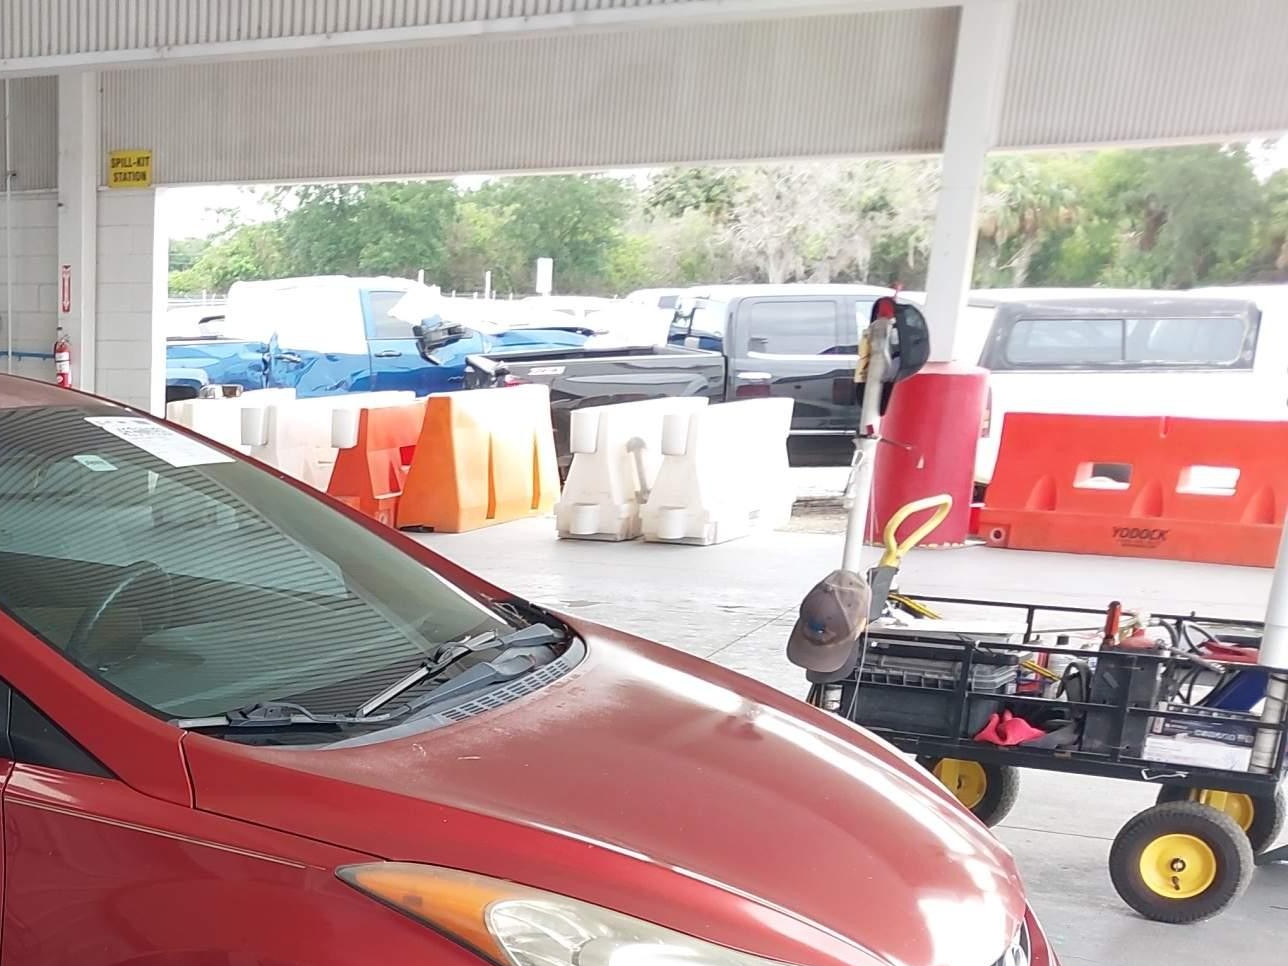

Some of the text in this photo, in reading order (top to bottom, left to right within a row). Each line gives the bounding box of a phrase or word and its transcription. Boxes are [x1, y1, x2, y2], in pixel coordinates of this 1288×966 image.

[111, 156, 149, 168] SPILL-KIT
[113, 171, 146, 182] STATION
[1112, 526, 1170, 541] YODOCK
